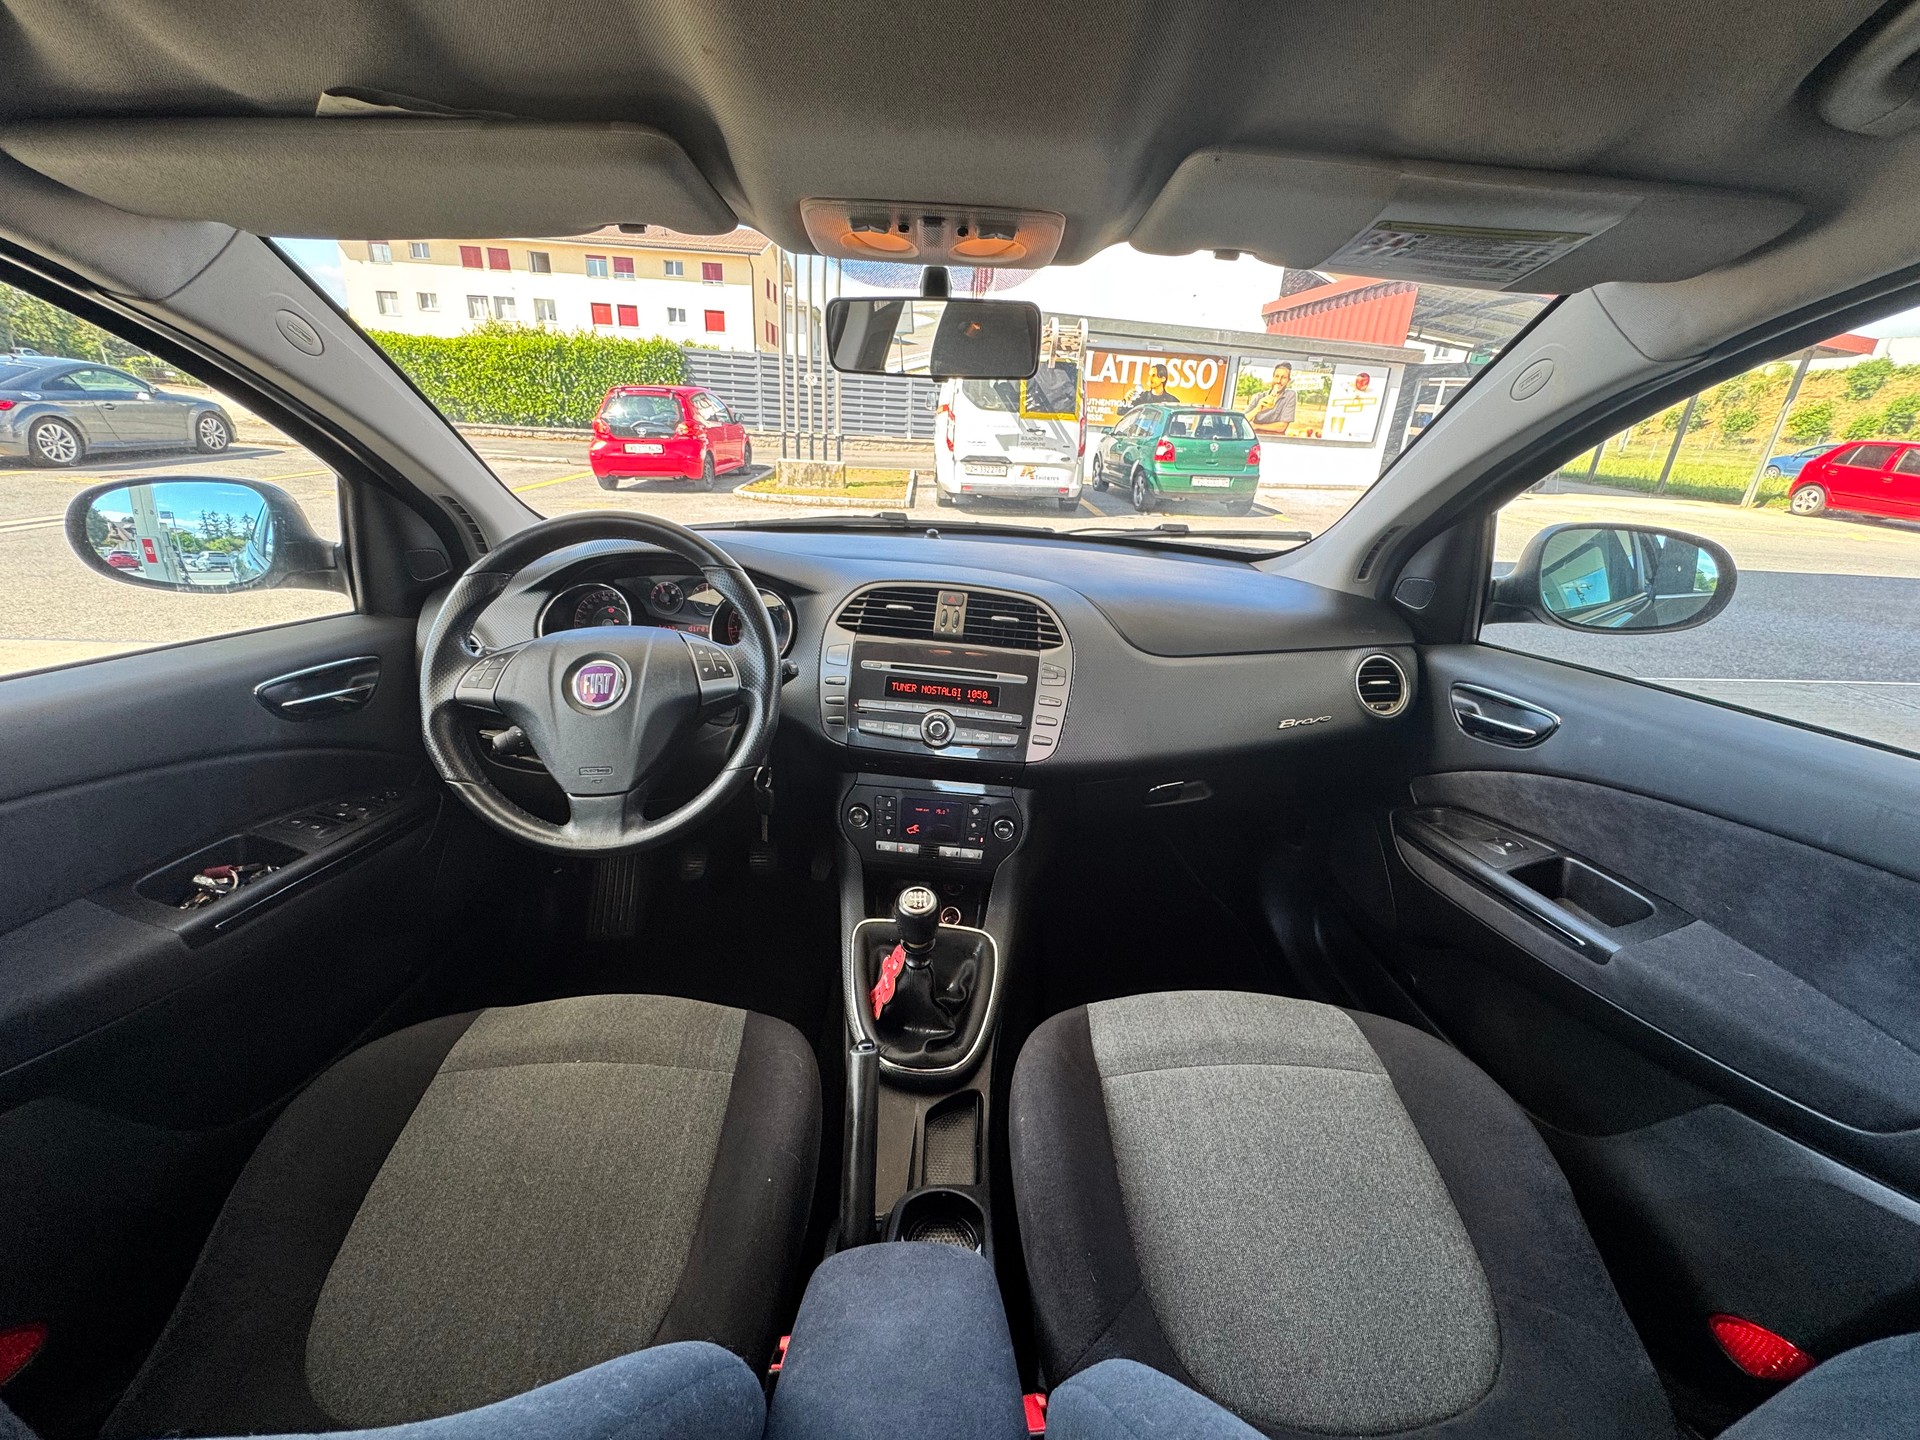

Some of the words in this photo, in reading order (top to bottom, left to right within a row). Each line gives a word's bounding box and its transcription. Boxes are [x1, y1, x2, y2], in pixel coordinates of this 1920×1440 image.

[583, 673, 613, 694] FIAT
[892, 682, 917, 693] TUNER
[921, 685, 961, 697] NOSTALGI
[966, 689, 988, 700] 1050
[1279, 715, 1332, 729] Bravo
